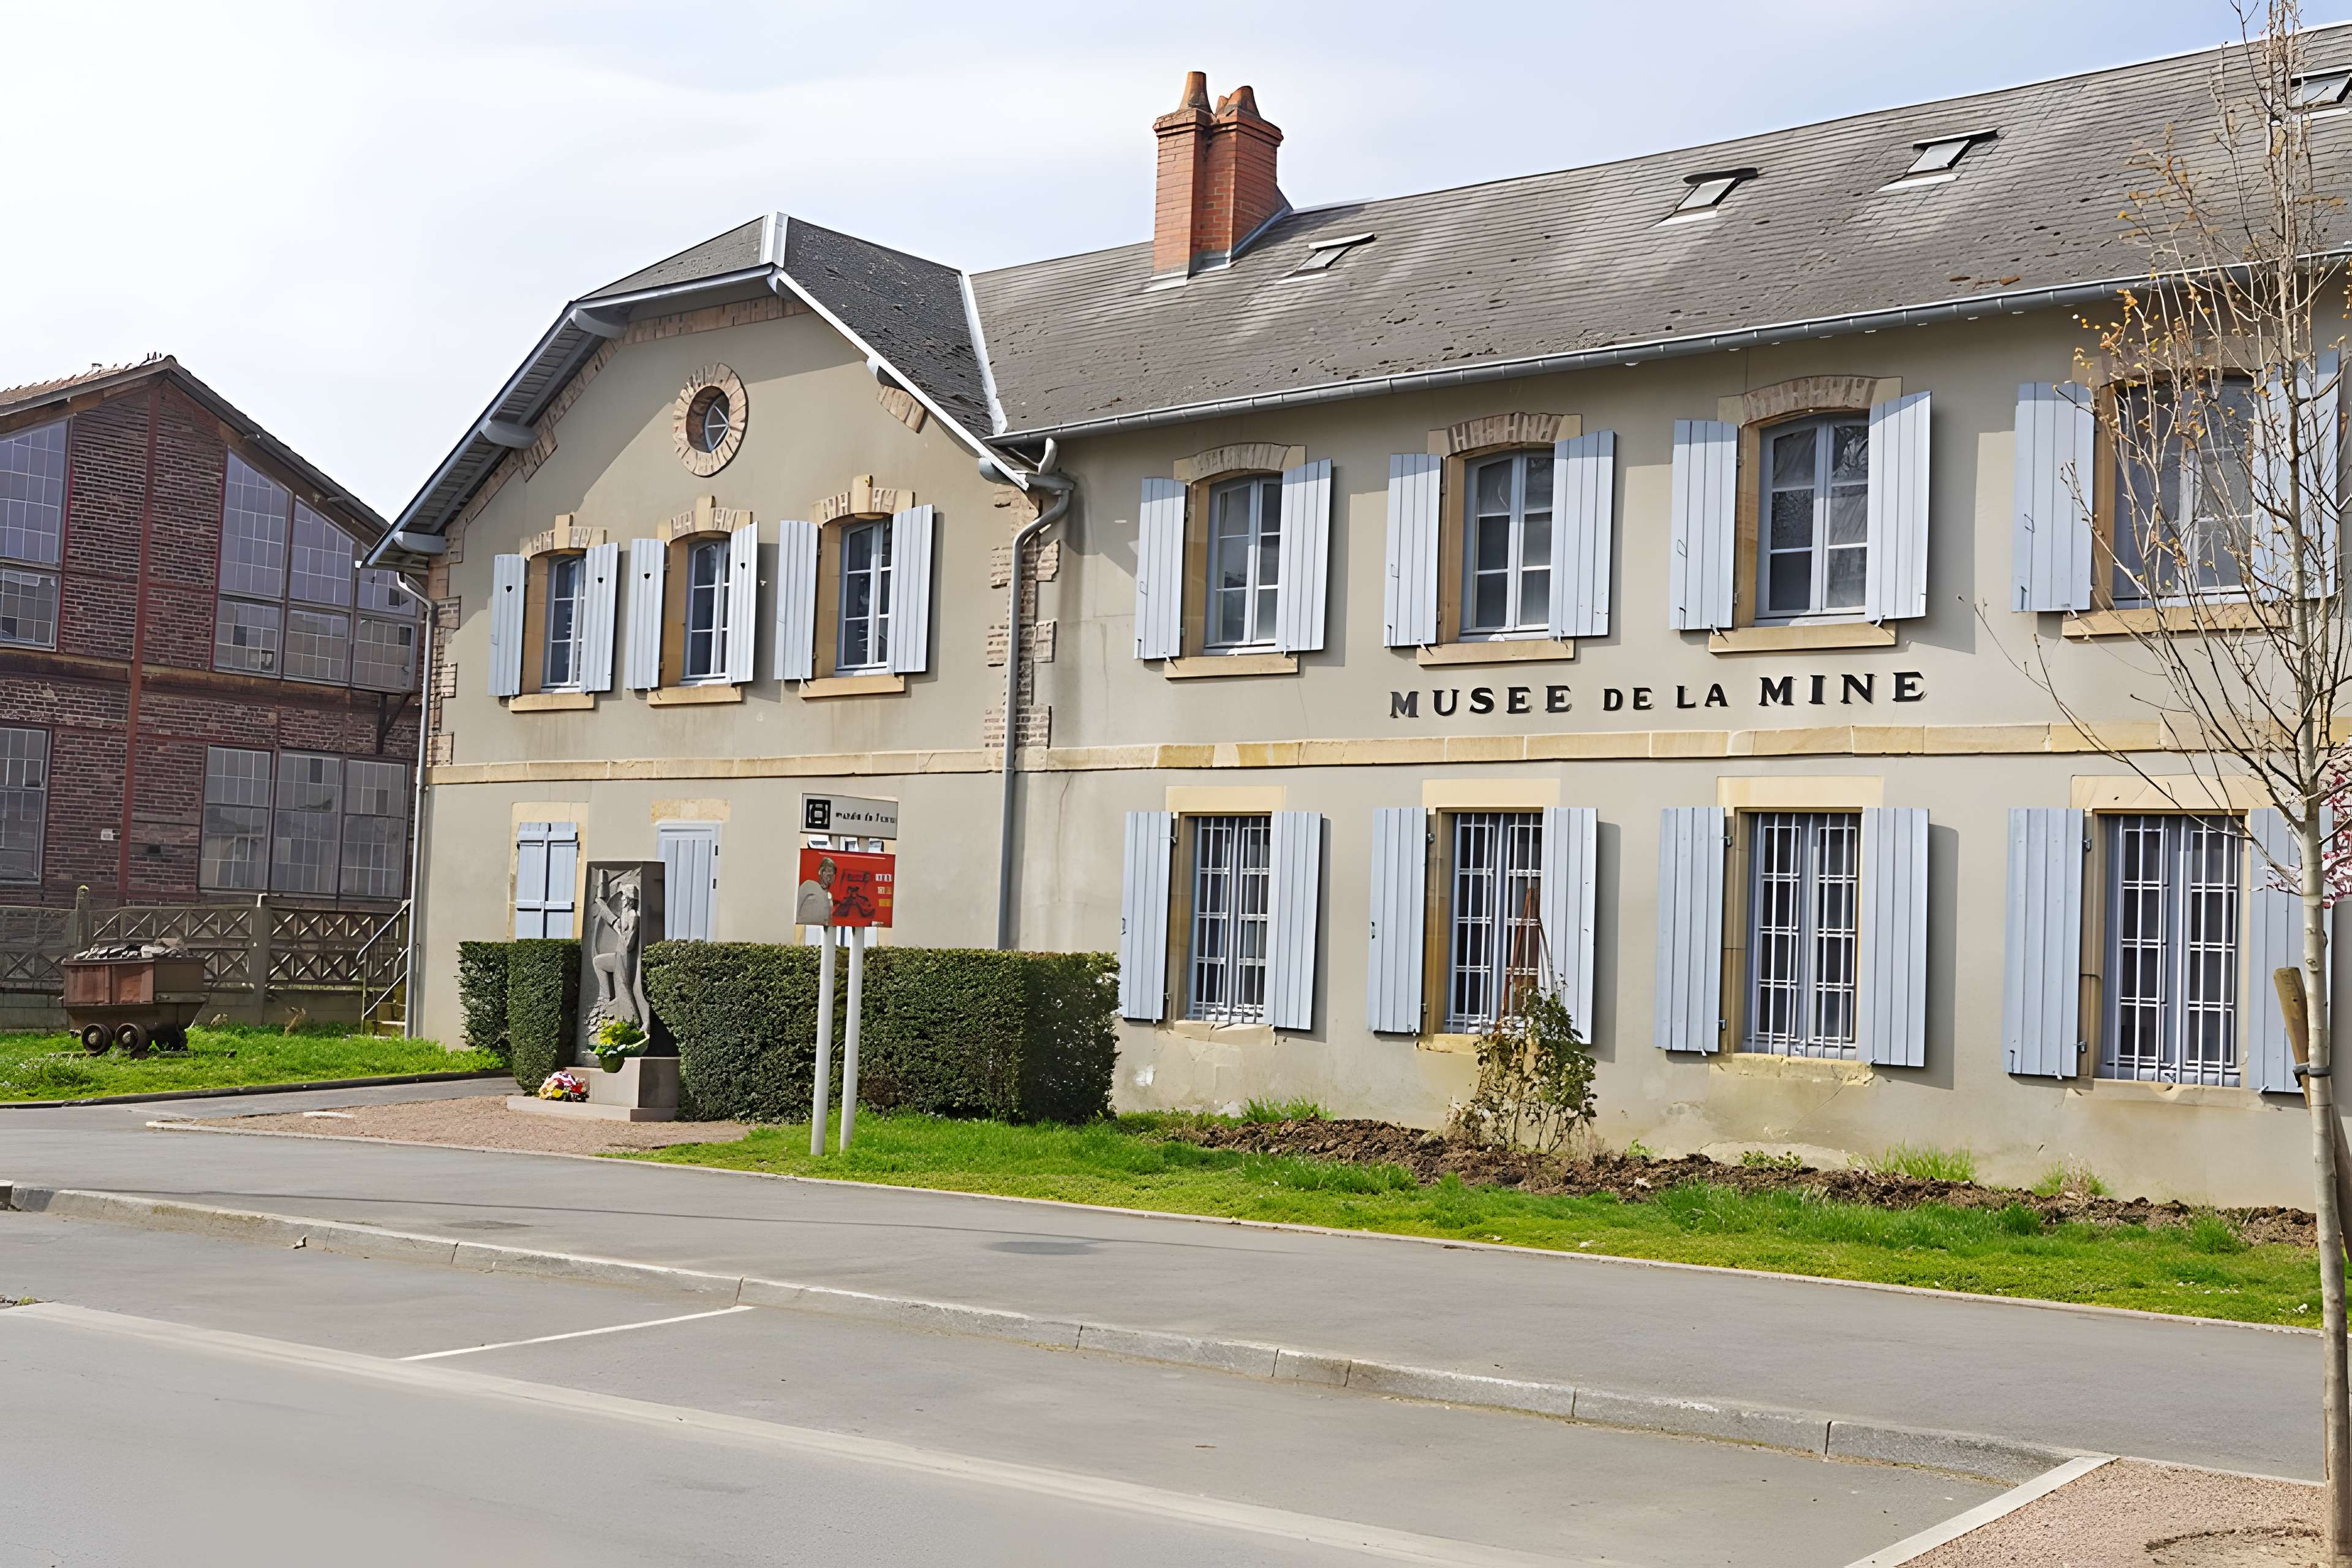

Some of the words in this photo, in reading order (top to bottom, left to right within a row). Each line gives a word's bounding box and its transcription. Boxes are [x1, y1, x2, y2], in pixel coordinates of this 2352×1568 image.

[1390, 685, 1572, 718] MUSEE
[1603, 687, 1654, 712] DE
[1676, 683, 1730, 709] LA
[1758, 671, 1927, 707] MINE
